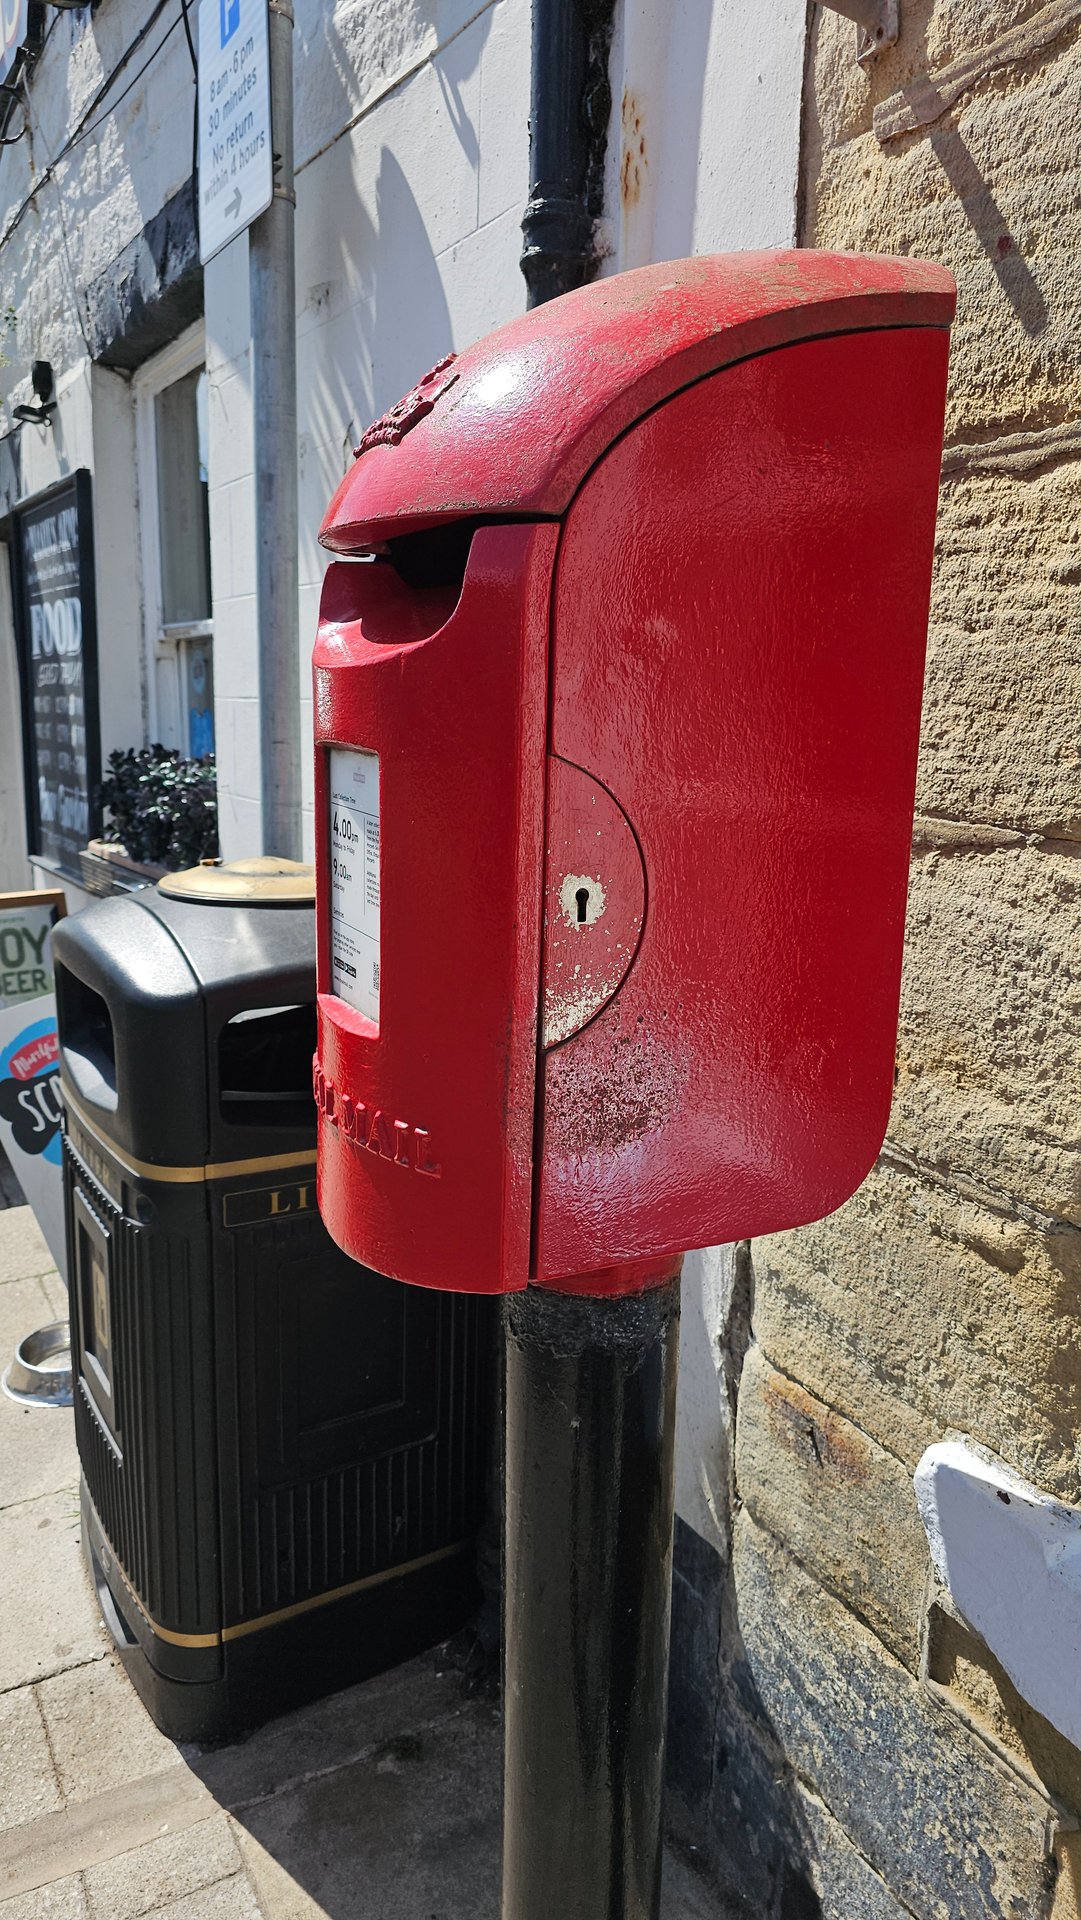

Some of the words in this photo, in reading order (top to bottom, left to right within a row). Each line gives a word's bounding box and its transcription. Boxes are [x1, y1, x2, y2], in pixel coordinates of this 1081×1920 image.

[208, 108, 220, 138] 30
[222, 68, 258, 118] minutes
[203, 171, 229, 206] within
[230, 154, 237, 177] 4
[239, 130, 266, 170] hours
[212, 145, 224, 169] No
[226, 110, 254, 151] return
[30, 597, 83, 659] FOOD
[0, 968, 48, 996] EER
[342, 1094, 442, 1179] MAIL
